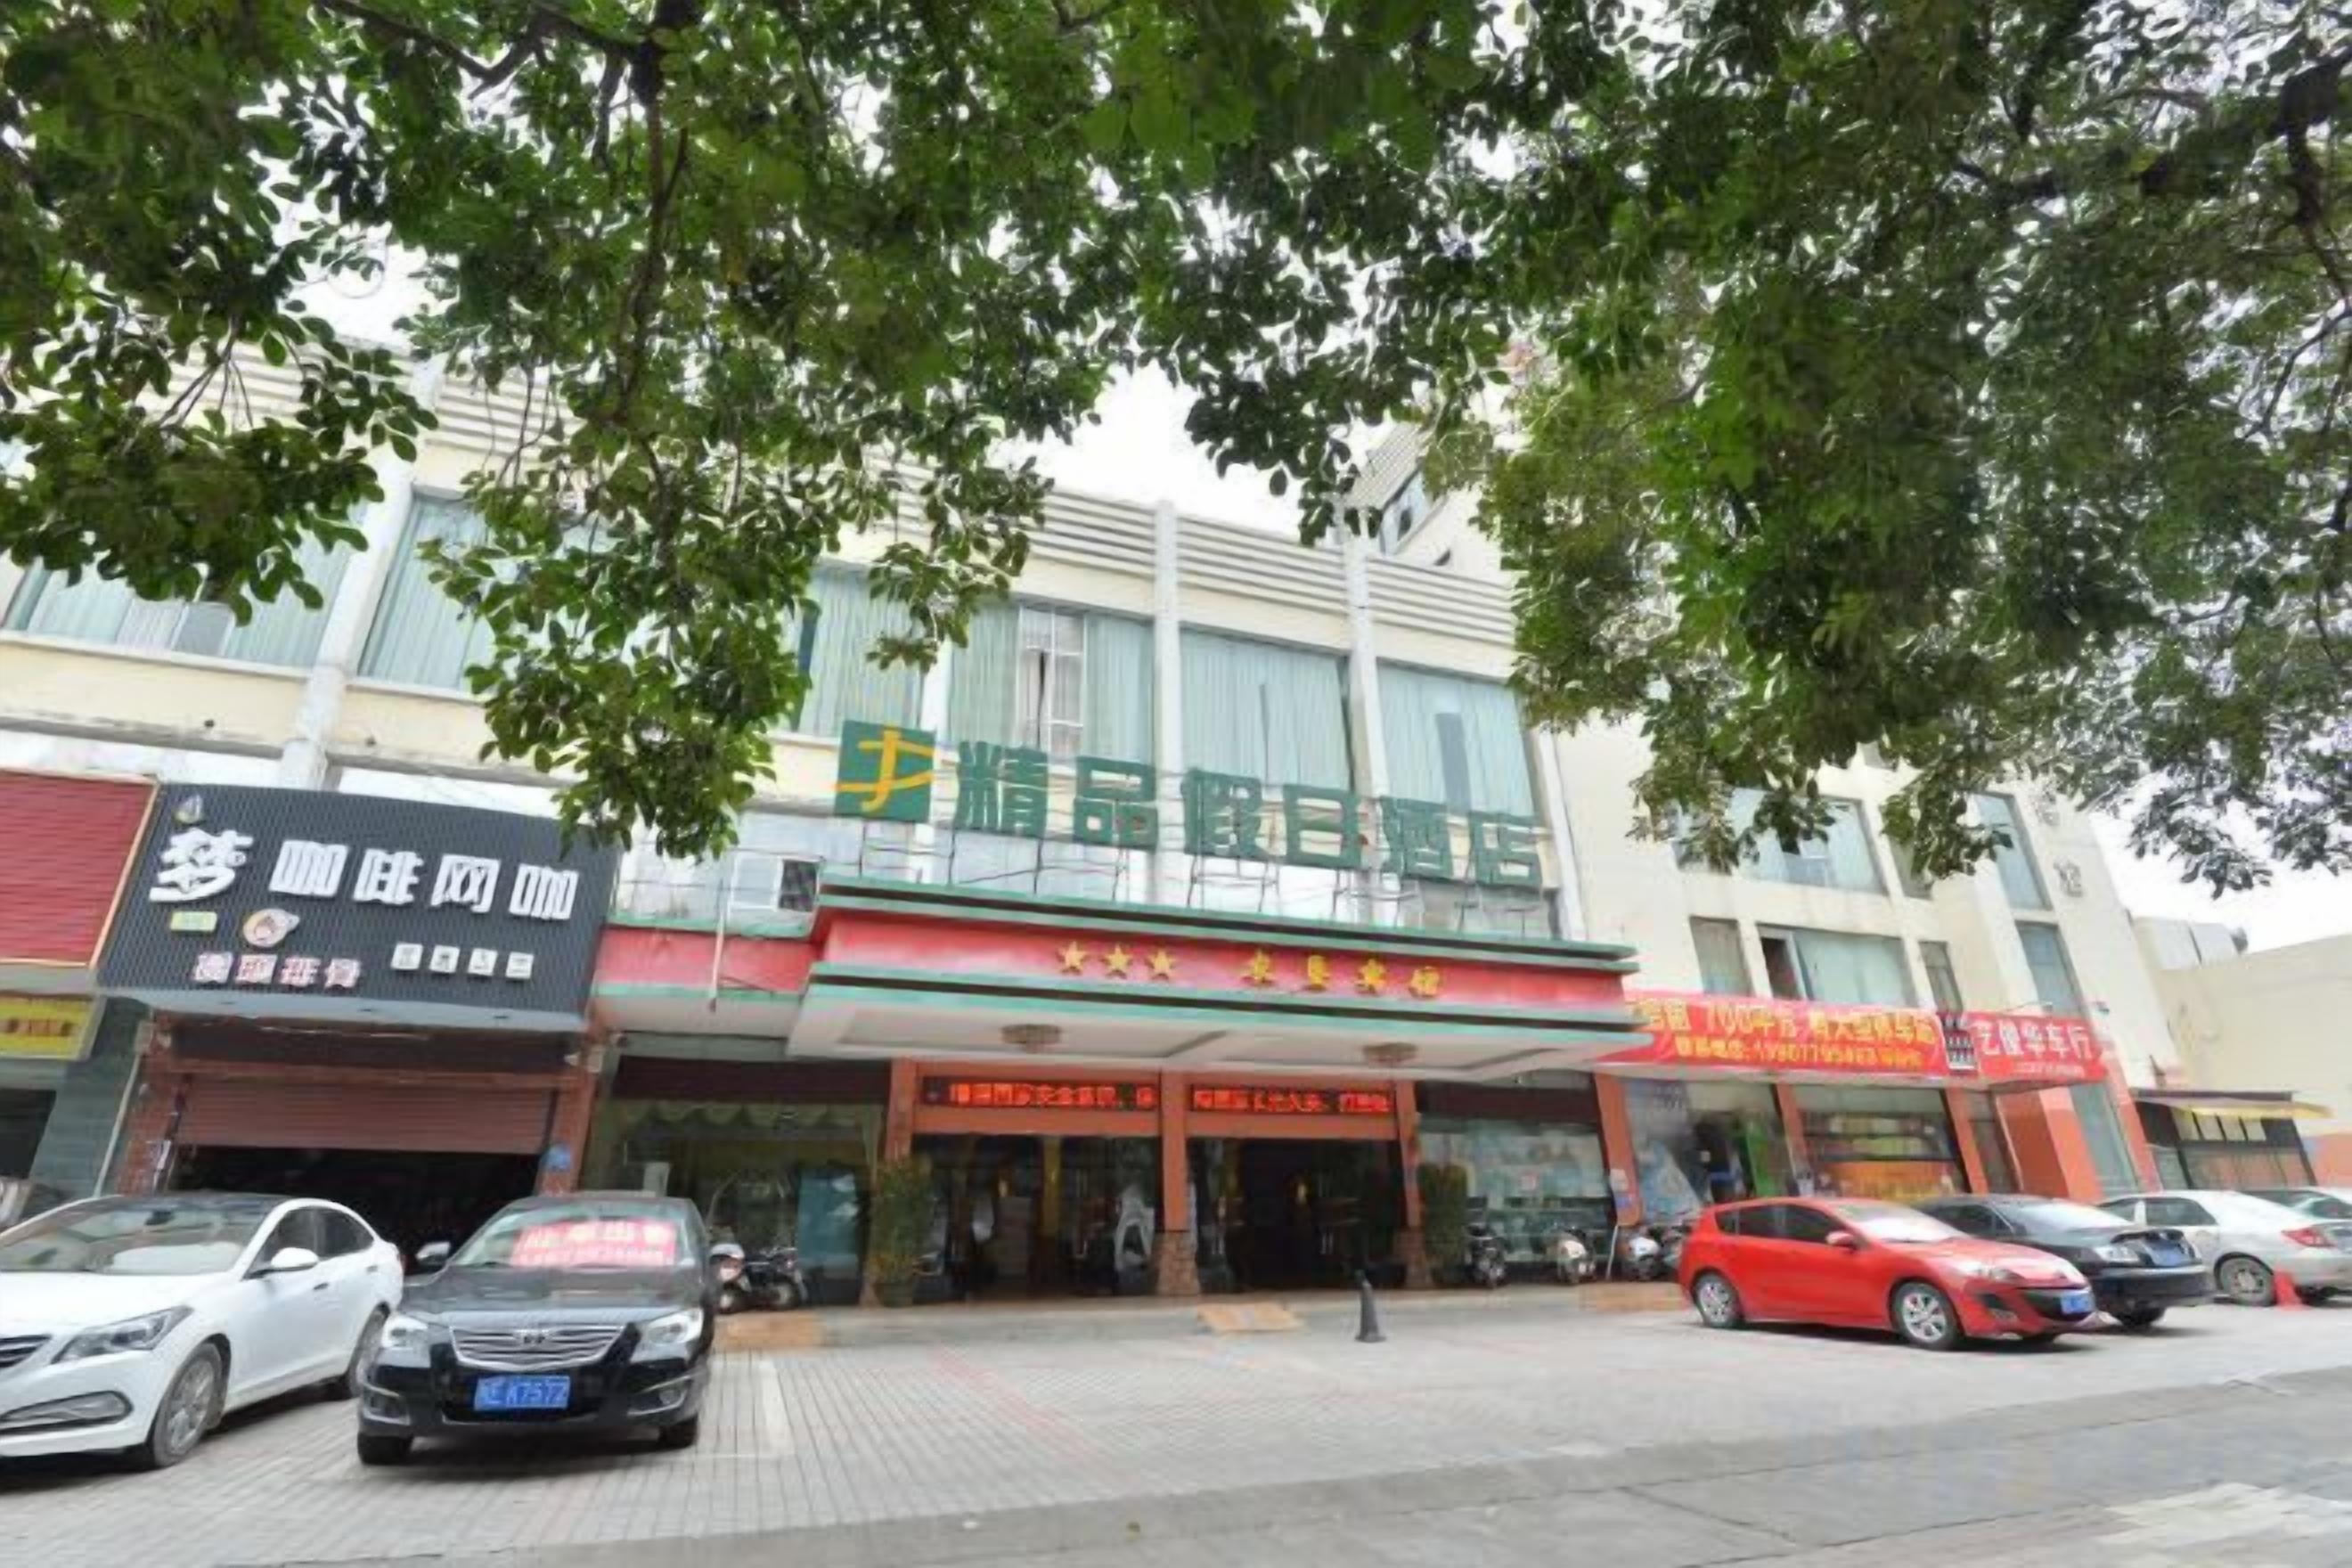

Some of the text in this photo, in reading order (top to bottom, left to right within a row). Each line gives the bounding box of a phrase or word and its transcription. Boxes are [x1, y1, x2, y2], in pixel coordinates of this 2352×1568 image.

[150, 827, 579, 921] 梦咖啡网咖
[954, 739, 1543, 890] 精品假日酒店
